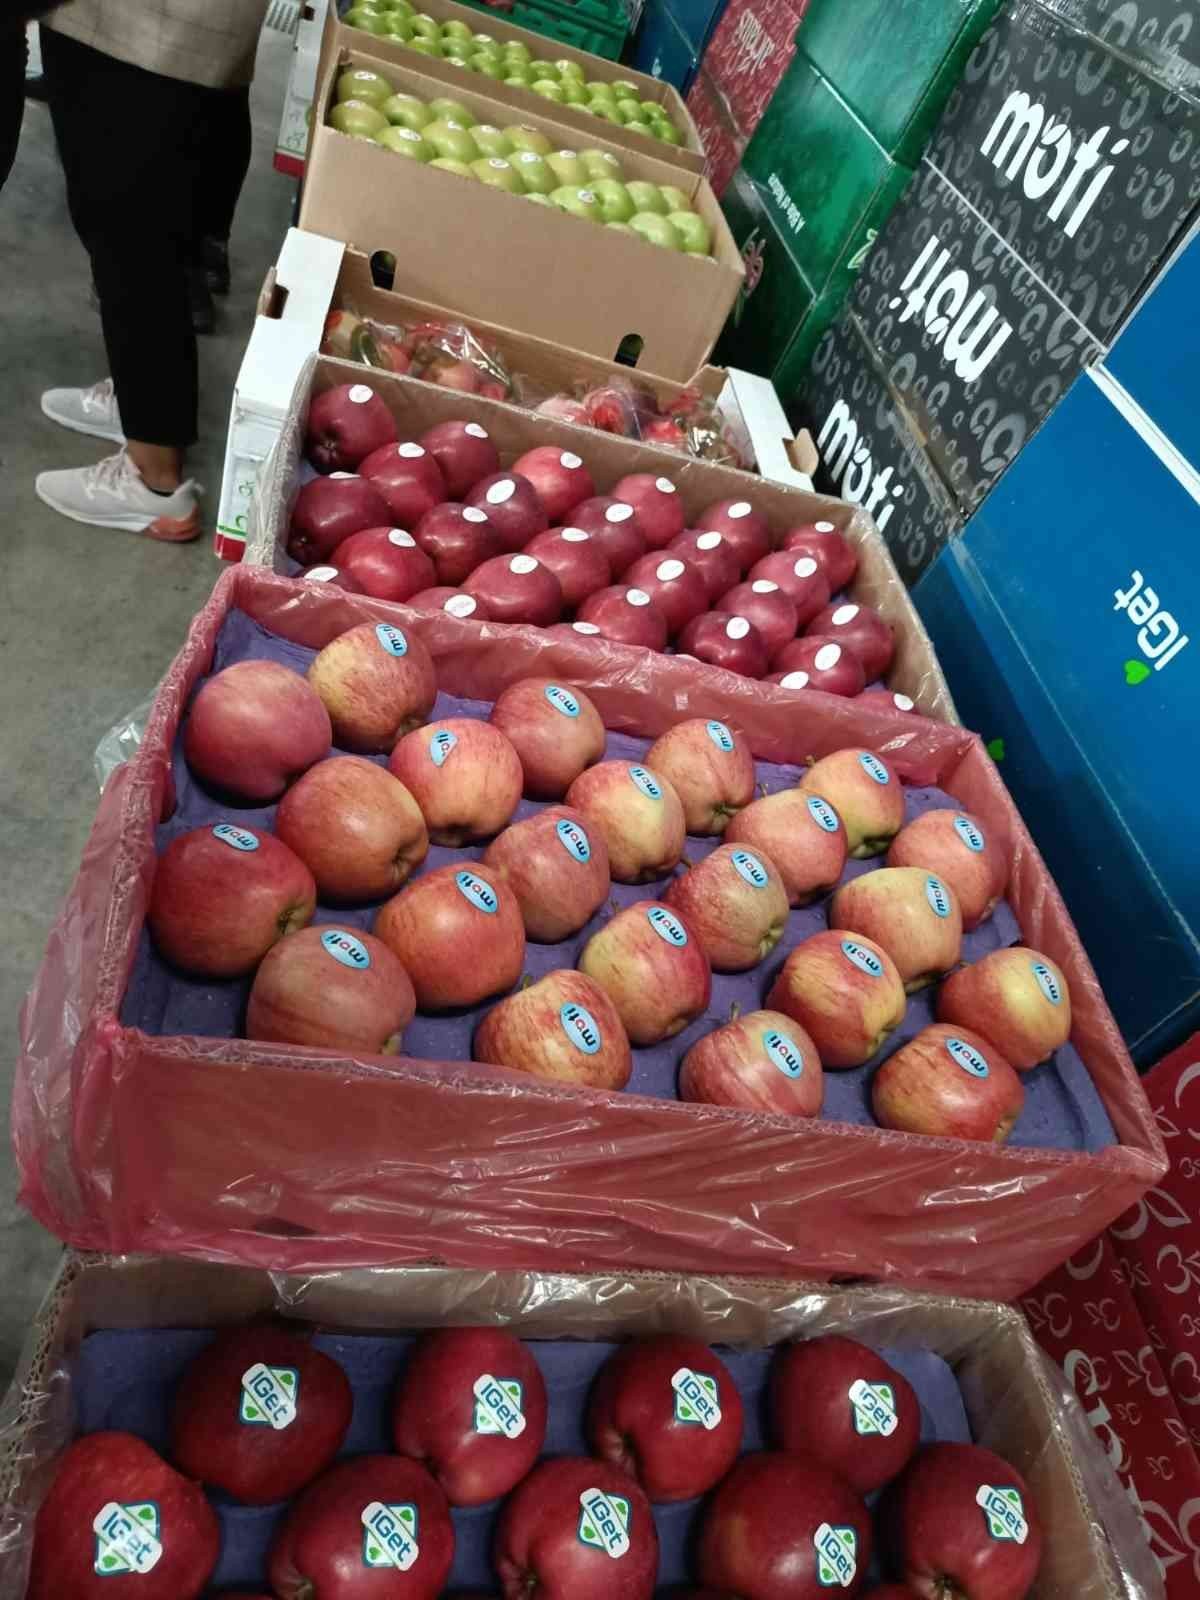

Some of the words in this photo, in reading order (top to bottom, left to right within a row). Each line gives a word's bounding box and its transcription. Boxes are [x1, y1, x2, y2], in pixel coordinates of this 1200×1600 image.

[1113, 569, 1189, 671] IGet
[379, 625, 403, 651] moti
[548, 688, 576, 712] moti
[435, 732, 451, 757] oti
[709, 724, 732, 748] moti
[632, 769, 659, 795] moti
[863, 755, 886, 780] moti
[810, 800, 834, 828] moti
[216, 826, 253, 847] moti
[559, 823, 587, 856] moti
[957, 820, 981, 847] moti
[735, 854, 764, 882] moti
[460, 875, 494, 906] moti
[929, 880, 946, 913] moti
[651, 910, 683, 941] moti
[326, 934, 366, 963] moti
[846, 944, 879, 971] moti
[1034, 965, 1058, 999] moti
[564, 1007, 596, 1047] moti
[767, 1035, 801, 1072] moti
[951, 1041, 985, 1072] moti
[249, 1371, 287, 1420] IGet
[480, 1383, 517, 1430] IGet
[680, 1376, 714, 1421] IGet
[587, 1496, 621, 1548] IGet
[985, 1492, 1021, 1536] IGet
[370, 1511, 409, 1560] IGet
[821, 1532, 850, 1579] IGet
